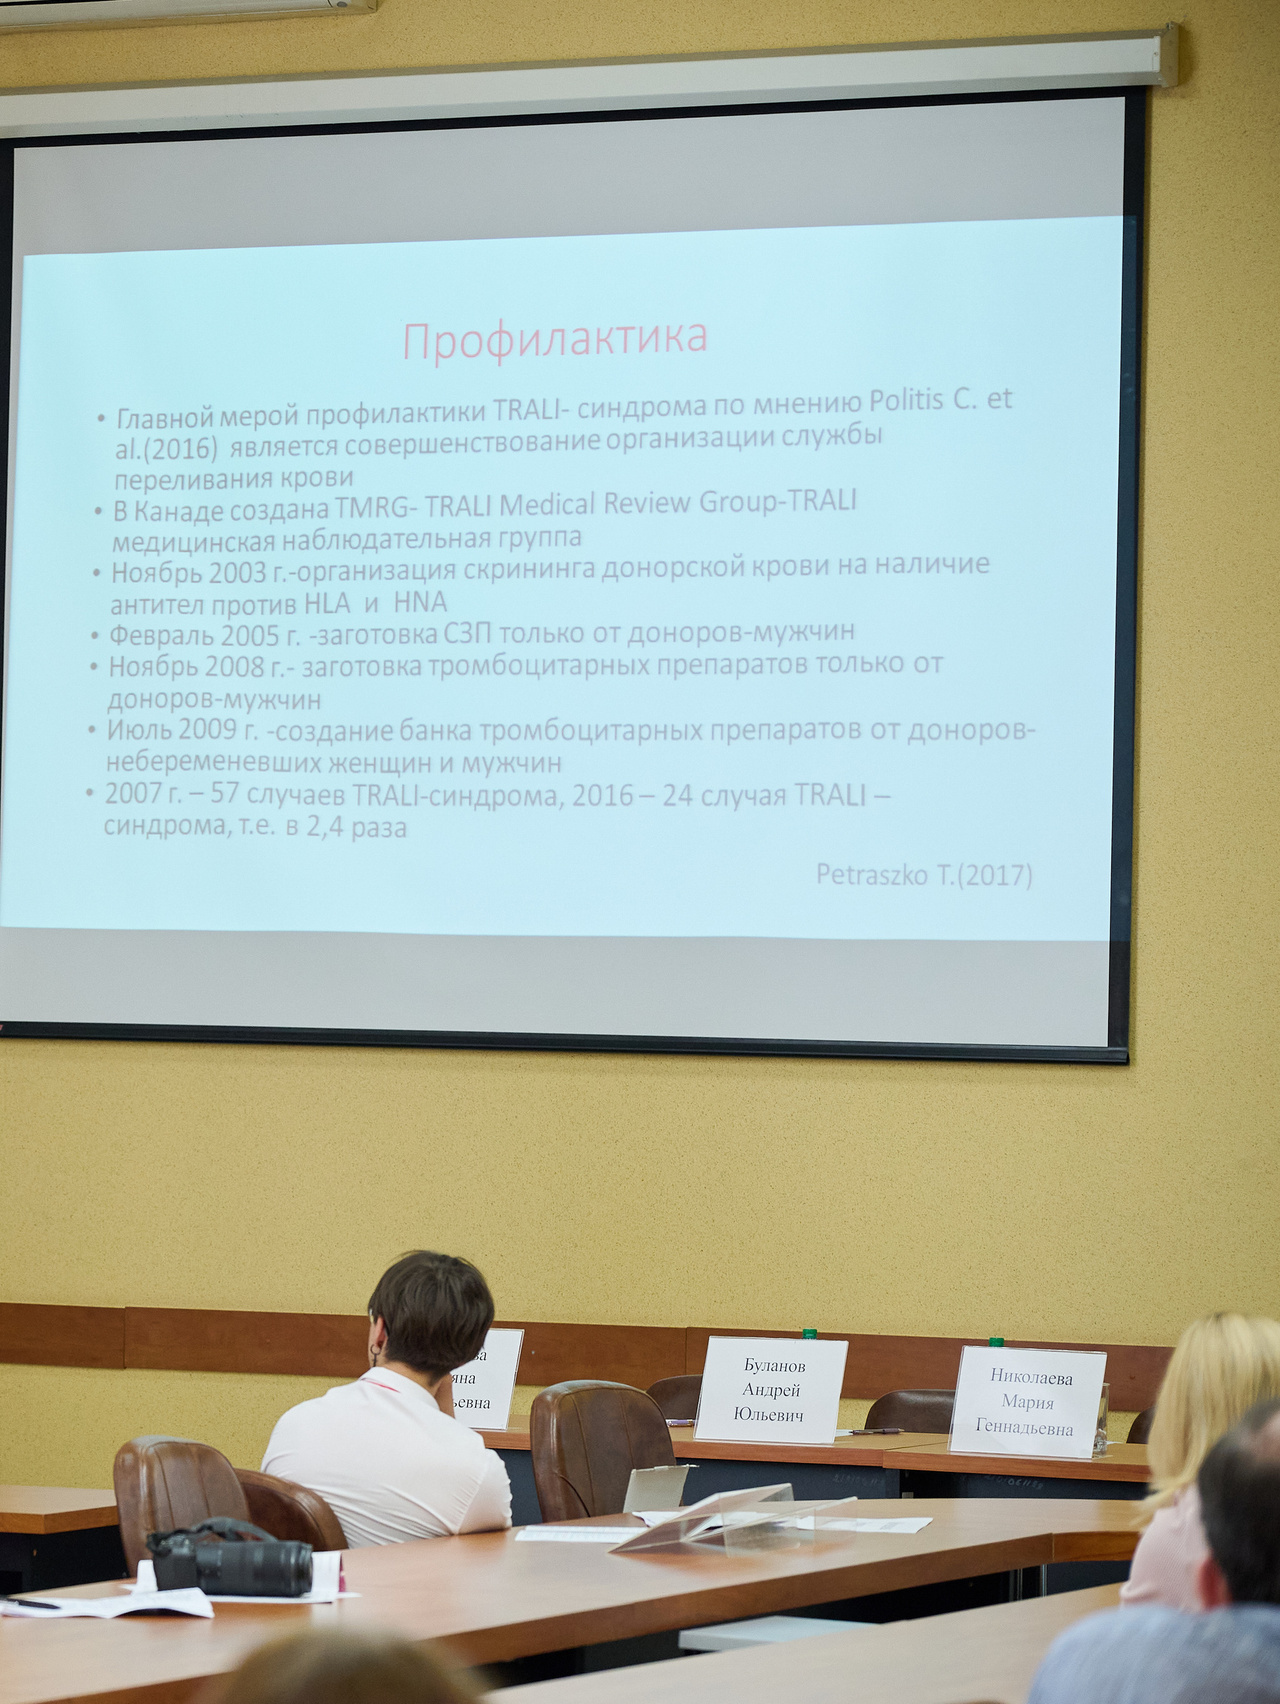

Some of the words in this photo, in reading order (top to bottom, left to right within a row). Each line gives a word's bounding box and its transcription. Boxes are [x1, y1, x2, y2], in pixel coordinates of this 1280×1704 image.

[404, 318, 707, 369] Профилактика
[118, 405, 213, 429] Главной
[220, 402, 298, 432] мерой
[307, 401, 485, 430] профилактики
[578, 399, 706, 423] синдрома
[715, 398, 745, 415] по
[754, 396, 862, 414] мнению
[870, 387, 943, 412] Politis
[954, 386, 977, 410] C.
[987, 388, 1013, 409] et
[116, 435, 218, 465] al.(2016)
[230, 439, 338, 458] является
[345, 433, 601, 460] совершенствование
[606, 430, 774, 455] организации
[782, 420, 882, 451] службы
[115, 471, 273, 495] переливания
[281, 470, 353, 493] крови
[114, 500, 127, 522] В
[135, 500, 224, 527] Канаде
[230, 502, 329, 525] создана
[425, 495, 491, 517] TRALI
[500, 491, 595, 516] Medical
[605, 491, 691, 514] Review
[700, 488, 856, 517] Group-TRALI
[112, 535, 275, 557] медицинская
[283, 527, 491, 554] наблюдательная
[499, 529, 582, 553] группа
[112, 560, 203, 588] Ноябрь
[209, 561, 266, 584] 2003
[464, 561, 595, 584] скрининга
[601, 553, 745, 583] донорской
[753, 559, 829, 582] крови
[839, 557, 867, 575] на
[876, 556, 990, 574] наличие
[111, 598, 204, 615] антител
[212, 598, 297, 621] против
[305, 591, 351, 614] HLA
[365, 597, 378, 613] и
[395, 590, 448, 613] HNA
[110, 624, 214, 650] Февраль
[221, 624, 279, 647] 2005
[287, 630, 300, 646] г.
[444, 621, 491, 644] СЗП
[499, 626, 584, 643] только
[593, 626, 621, 643] от
[627, 623, 854, 648] доноров-мужчин
[110, 653, 198, 681] Ноябрь
[205, 655, 264, 678] 2008
[303, 659, 422, 678] заготовка
[428, 652, 649, 681] тромбоцитарных
[658, 657, 808, 681] препаратов
[816, 655, 904, 673] только
[914, 656, 944, 673] от
[107, 692, 321, 715] доноров-мужчин
[108, 719, 172, 740] Июль
[179, 717, 237, 740] 2009
[245, 724, 258, 740] г.
[400, 717, 471, 741] банка
[480, 717, 703, 746] тромбоцитарных
[711, 722, 862, 746] препаратов
[871, 722, 901, 740] от
[907, 722, 1036, 745] доноров-
[107, 748, 322, 776] небеременевших
[329, 756, 431, 778] женщин
[440, 757, 453, 773] и
[462, 756, 561, 778] мужчин
[105, 781, 162, 804] 2007
[169, 787, 181, 803] г.
[211, 781, 239, 803] 57
[247, 787, 345, 809] случаев
[352, 784, 564, 812] TRALI-синдрома,
[573, 784, 633, 807] 2016
[663, 783, 693, 807] 24
[701, 788, 786, 812] случая
[794, 782, 865, 806] TRALI
[104, 818, 232, 840] синдрома,
[286, 819, 298, 836] в
[307, 814, 344, 841] 2,4
[352, 821, 407, 843] раза
[818, 863, 928, 886] Petraszko
[937, 863, 1032, 890] T.(2017)
[744, 1357, 806, 1375] Буланов
[991, 1367, 1073, 1385] Николаева
[742, 1382, 801, 1400] Андрей
[1002, 1393, 1054, 1412] Мария
[734, 1406, 804, 1422] Юльевич
[975, 1417, 1074, 1436] Геннадьевна
